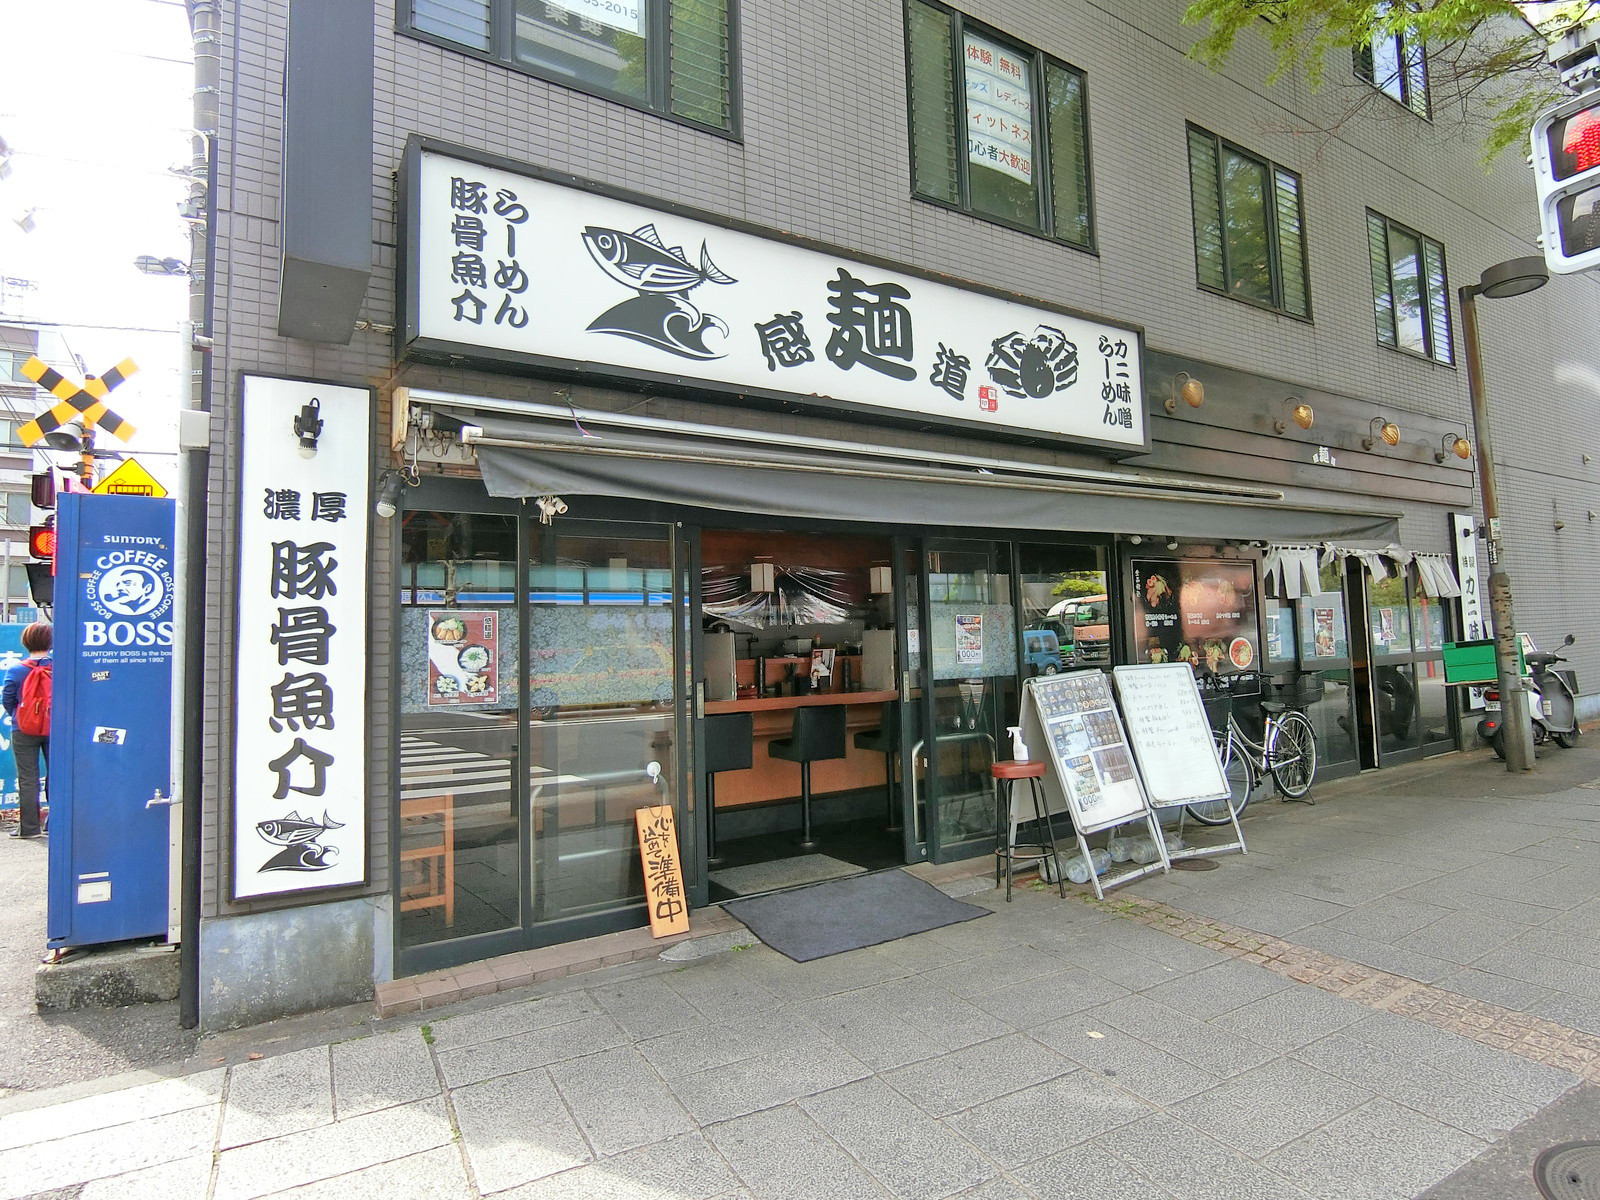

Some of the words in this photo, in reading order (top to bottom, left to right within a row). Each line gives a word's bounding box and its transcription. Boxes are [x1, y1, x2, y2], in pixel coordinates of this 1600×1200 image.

[967, 44, 993, 67] 体験
[1000, 57, 1022, 80] 無料
[966, 108, 1031, 145] ィットネス
[451, 176, 488, 325] 豚骨魚介
[493, 188, 529, 328] らーめん
[754, 267, 972, 401] 感麺道
[1097, 334, 1118, 427] らーめん
[1114, 338, 1133, 430] カニ味噌
[263, 489, 347, 522] 濃厚
[103, 535, 162, 544] SUNTORY
[97, 549, 168, 572] COFFEE
[86, 569, 102, 600] COFFEE
[90, 600, 113, 620] BOSS
[148, 594, 174, 620] COFFEE
[83, 621, 173, 646] BOSS
[268, 540, 337, 800] 豚骨魚介
[647, 854, 683, 923] 準備中
